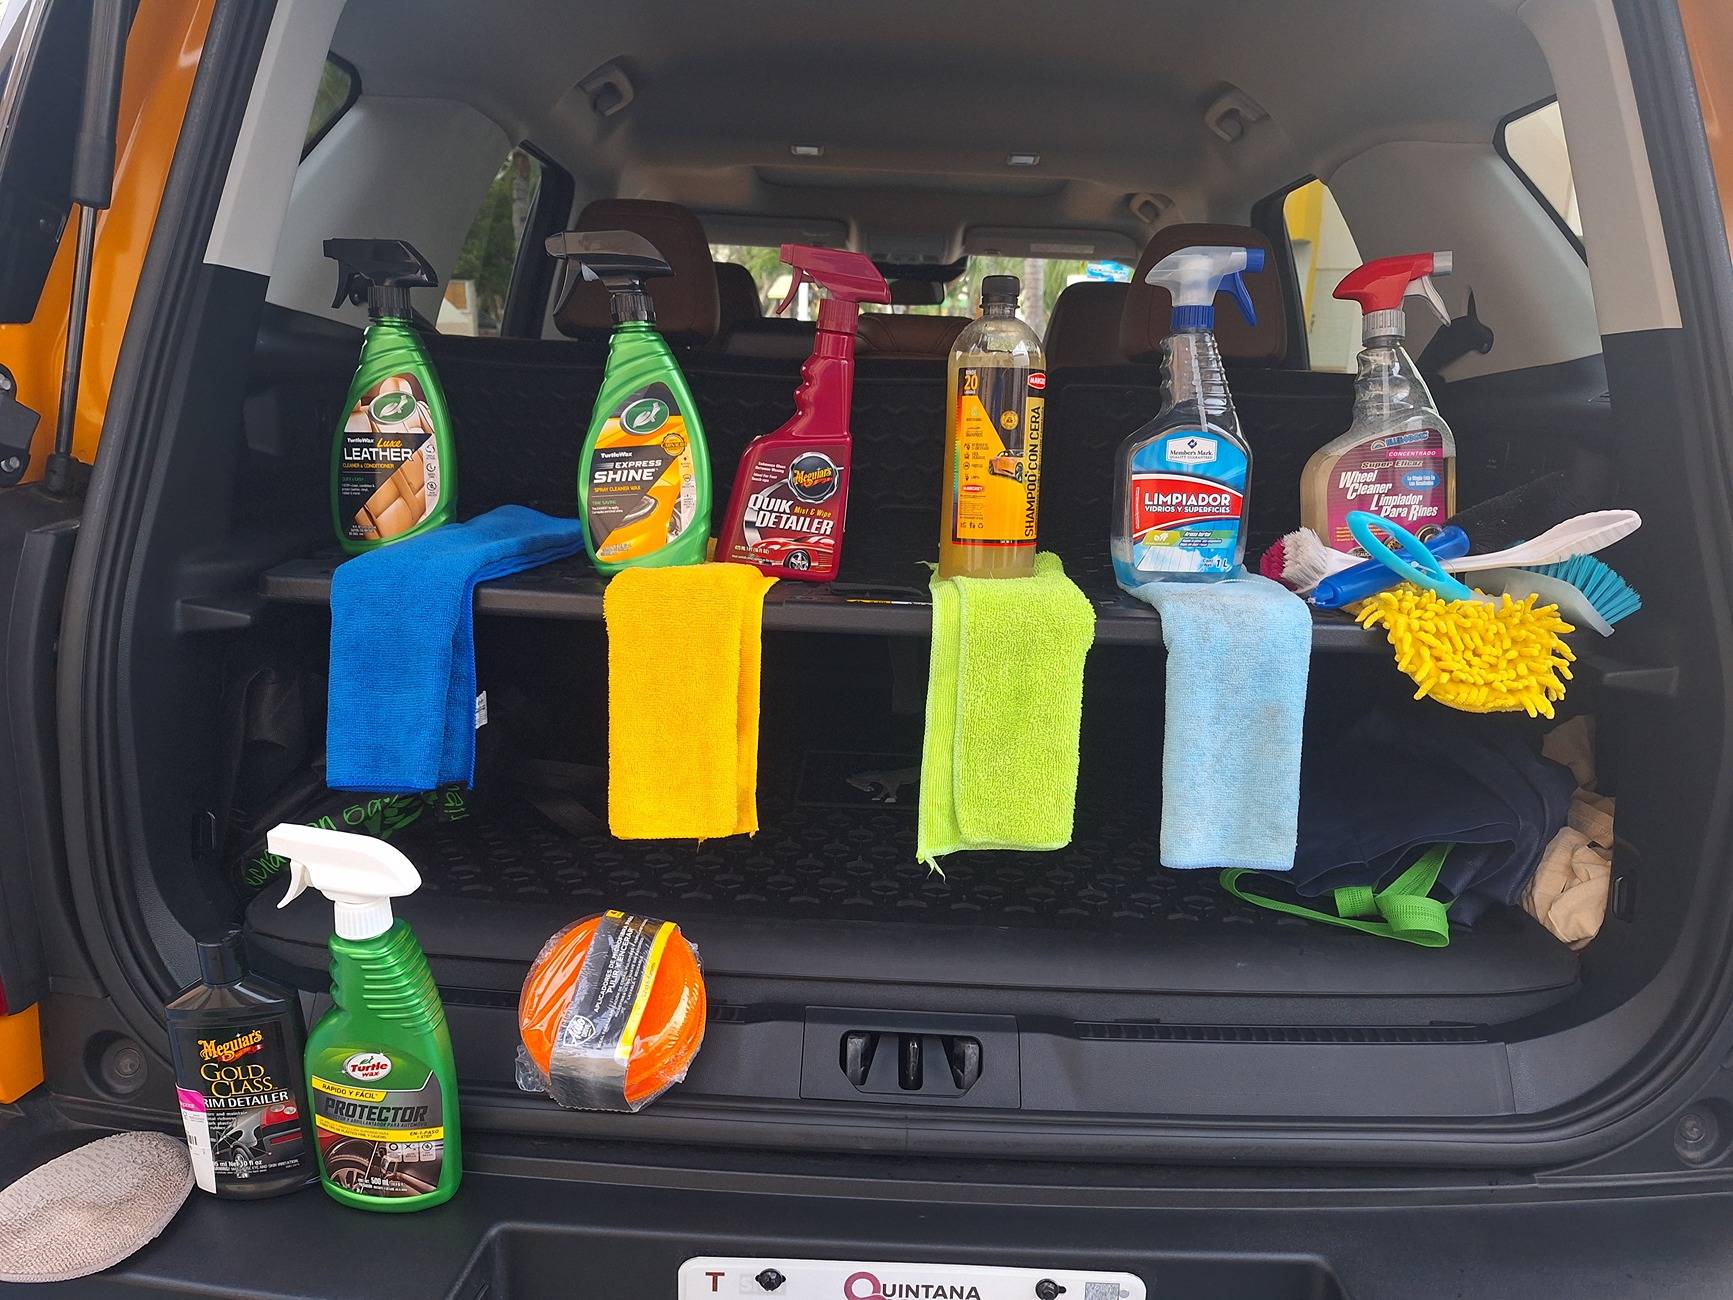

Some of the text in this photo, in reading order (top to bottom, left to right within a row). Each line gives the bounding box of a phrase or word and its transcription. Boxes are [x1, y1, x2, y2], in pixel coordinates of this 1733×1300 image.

[964, 375, 978, 390] 20
[377, 438, 402, 448] Luxe
[344, 448, 414, 461] LEATHER
[615, 460, 662, 469] EXPRESS
[1025, 406, 1041, 537] SHAMPOO CON CERA
[1361, 461, 1394, 469] Super
[594, 468, 655, 483] SHINE
[792, 467, 832, 488] Meguiar's
[1339, 470, 1378, 488] Wheel
[1145, 493, 1231, 506] LIMPIADOR
[1346, 483, 1392, 499] Cleaner
[748, 493, 794, 514] QUIK
[1370, 493, 1423, 510] Limpiador
[816, 509, 832, 518] Wipe
[1380, 505, 1438, 521] Para Rines
[756, 509, 834, 535] DETAILER
[606, 970, 619, 993] PULIR
[618, 927, 634, 962] ENCERAR
[594, 970, 612, 1012] APLICADORES
[608, 959, 615, 968] DE
[197, 1030, 263, 1061] Meguiar's
[201, 1063, 265, 1081] GOLD
[350, 1062, 388, 1072] Turtle
[212, 1076, 273, 1098] CLASS
[355, 1090, 375, 1099] FÁCIL
[204, 1098, 225, 1108] RIM
[228, 1091, 289, 1108] DETAILER
[325, 1097, 428, 1122] PROTECTOR
[370, 1177, 381, 1185] 500
[705, 1272, 725, 1292] T
[844, 1271, 981, 1300] QUINTANA
